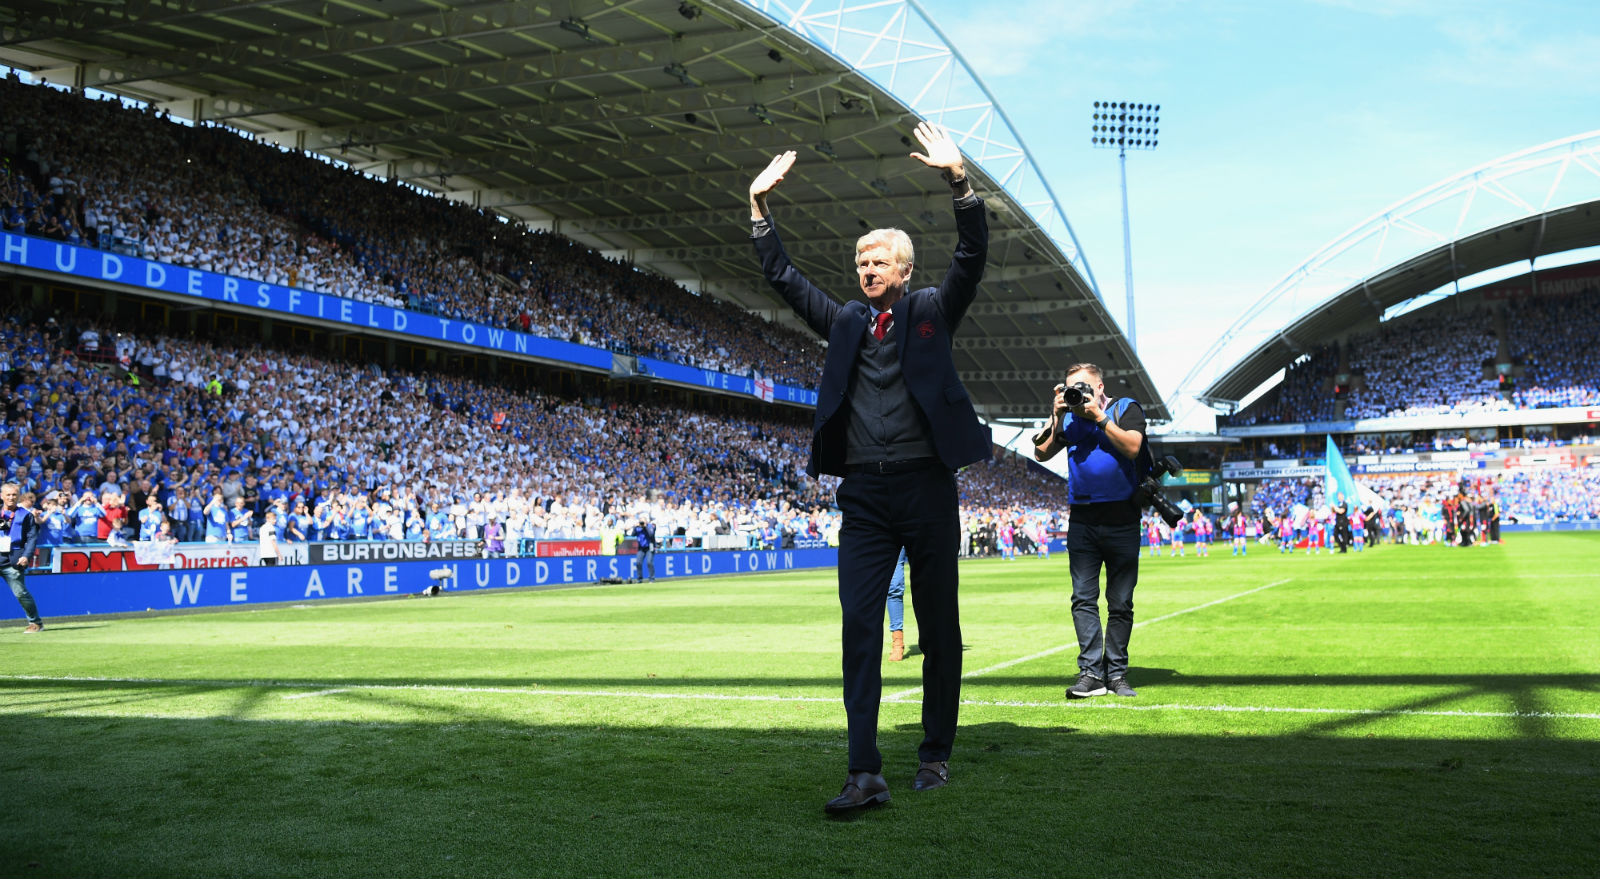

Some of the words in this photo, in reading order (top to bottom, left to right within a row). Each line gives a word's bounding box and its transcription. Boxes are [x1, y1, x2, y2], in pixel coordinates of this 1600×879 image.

[4, 234, 407, 330] HUDDERSFIELD
[440, 319, 527, 353] TOWN
[705, 371, 728, 390] WE
[1238, 469, 1282, 477] NORTHERN
[168, 572, 247, 605] WE
[304, 566, 398, 597] ARE
[443, 554, 711, 589] HUDDERSFELD
[733, 552, 793, 571] TOWN
